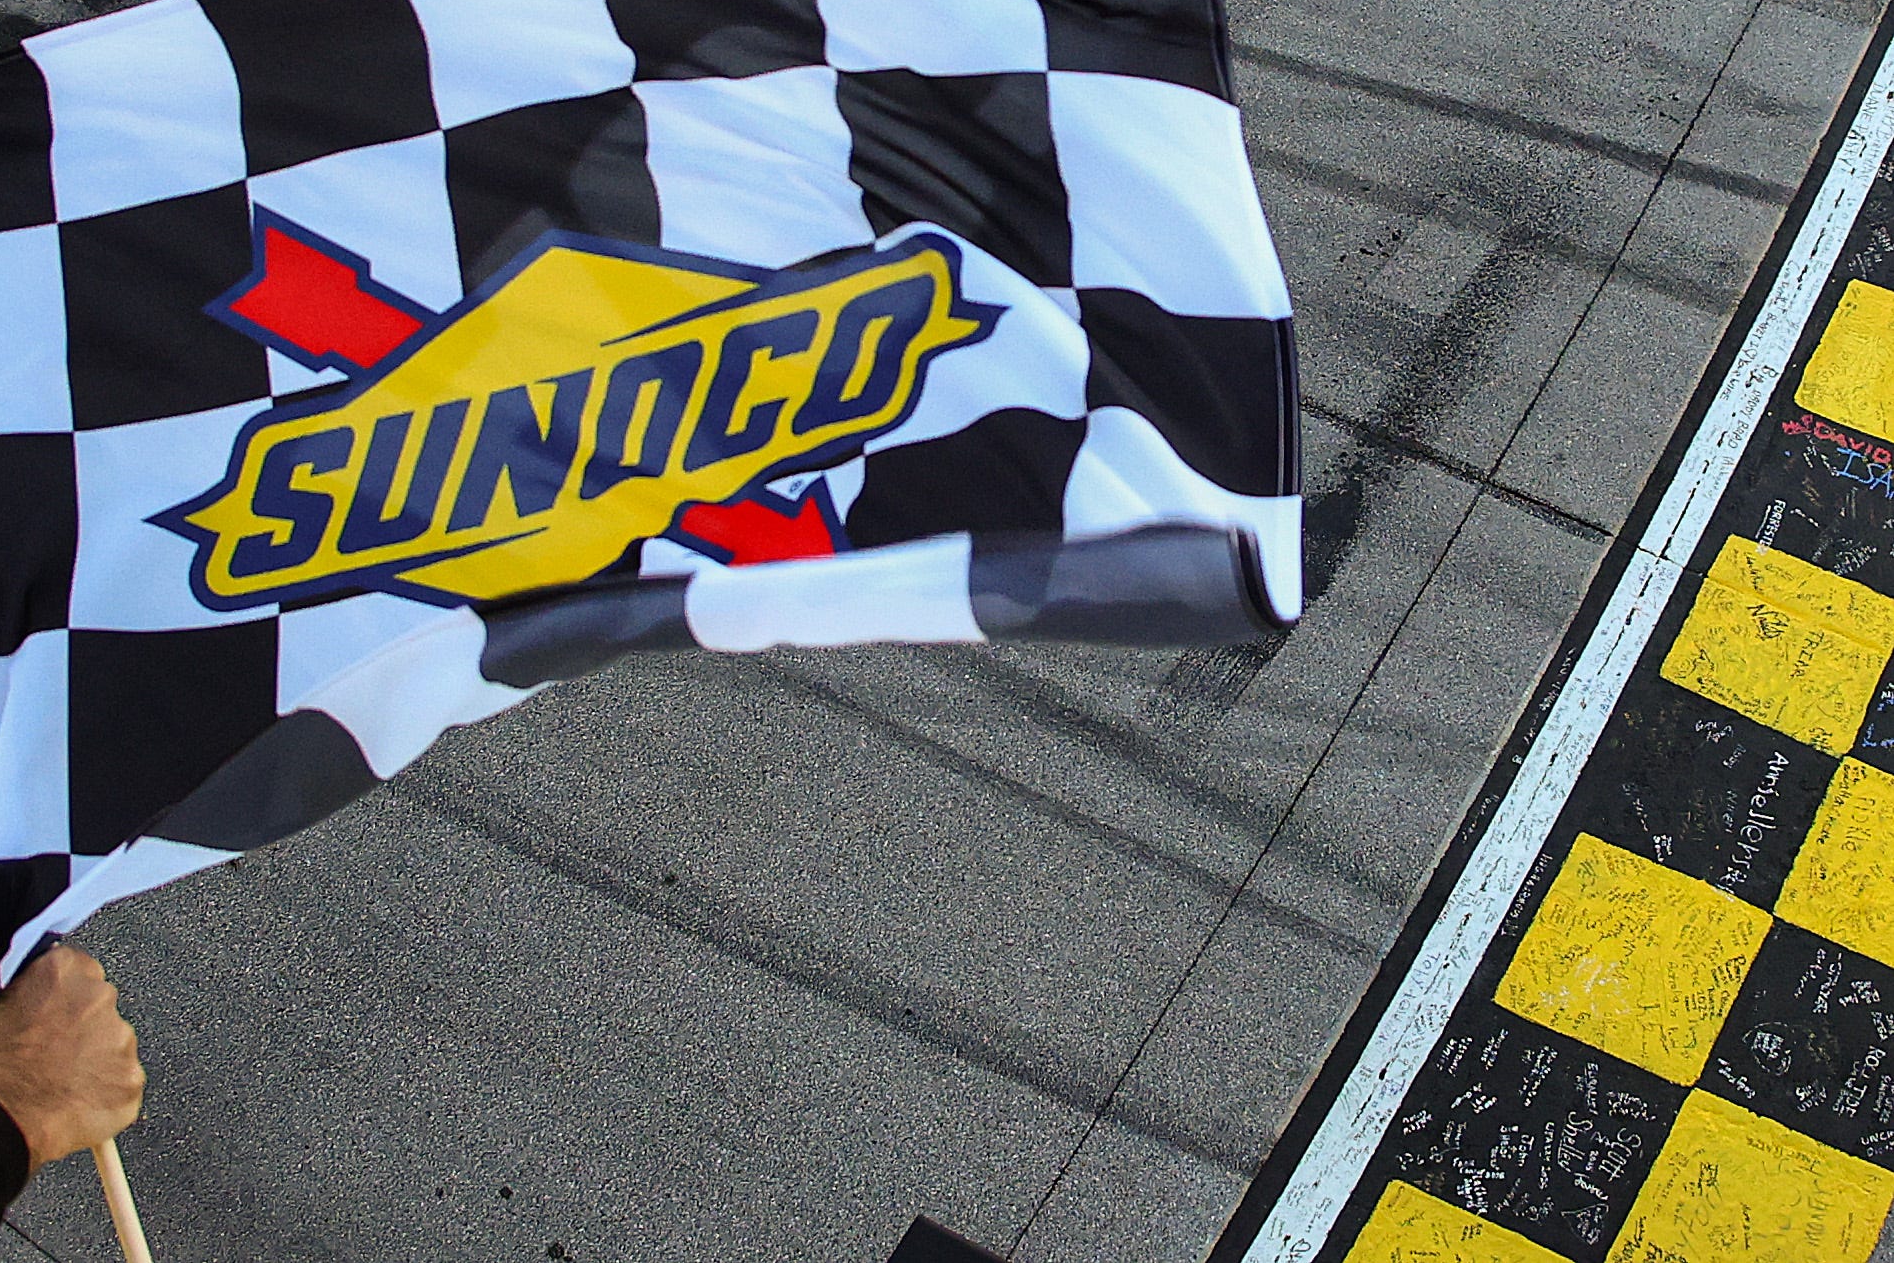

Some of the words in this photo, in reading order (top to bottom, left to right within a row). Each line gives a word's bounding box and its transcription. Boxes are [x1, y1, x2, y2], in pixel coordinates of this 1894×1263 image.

[227, 274, 938, 577] SUNOCO
[1558, 1110, 1594, 1173] Shelley
[1597, 1128, 1642, 1183] Scott
